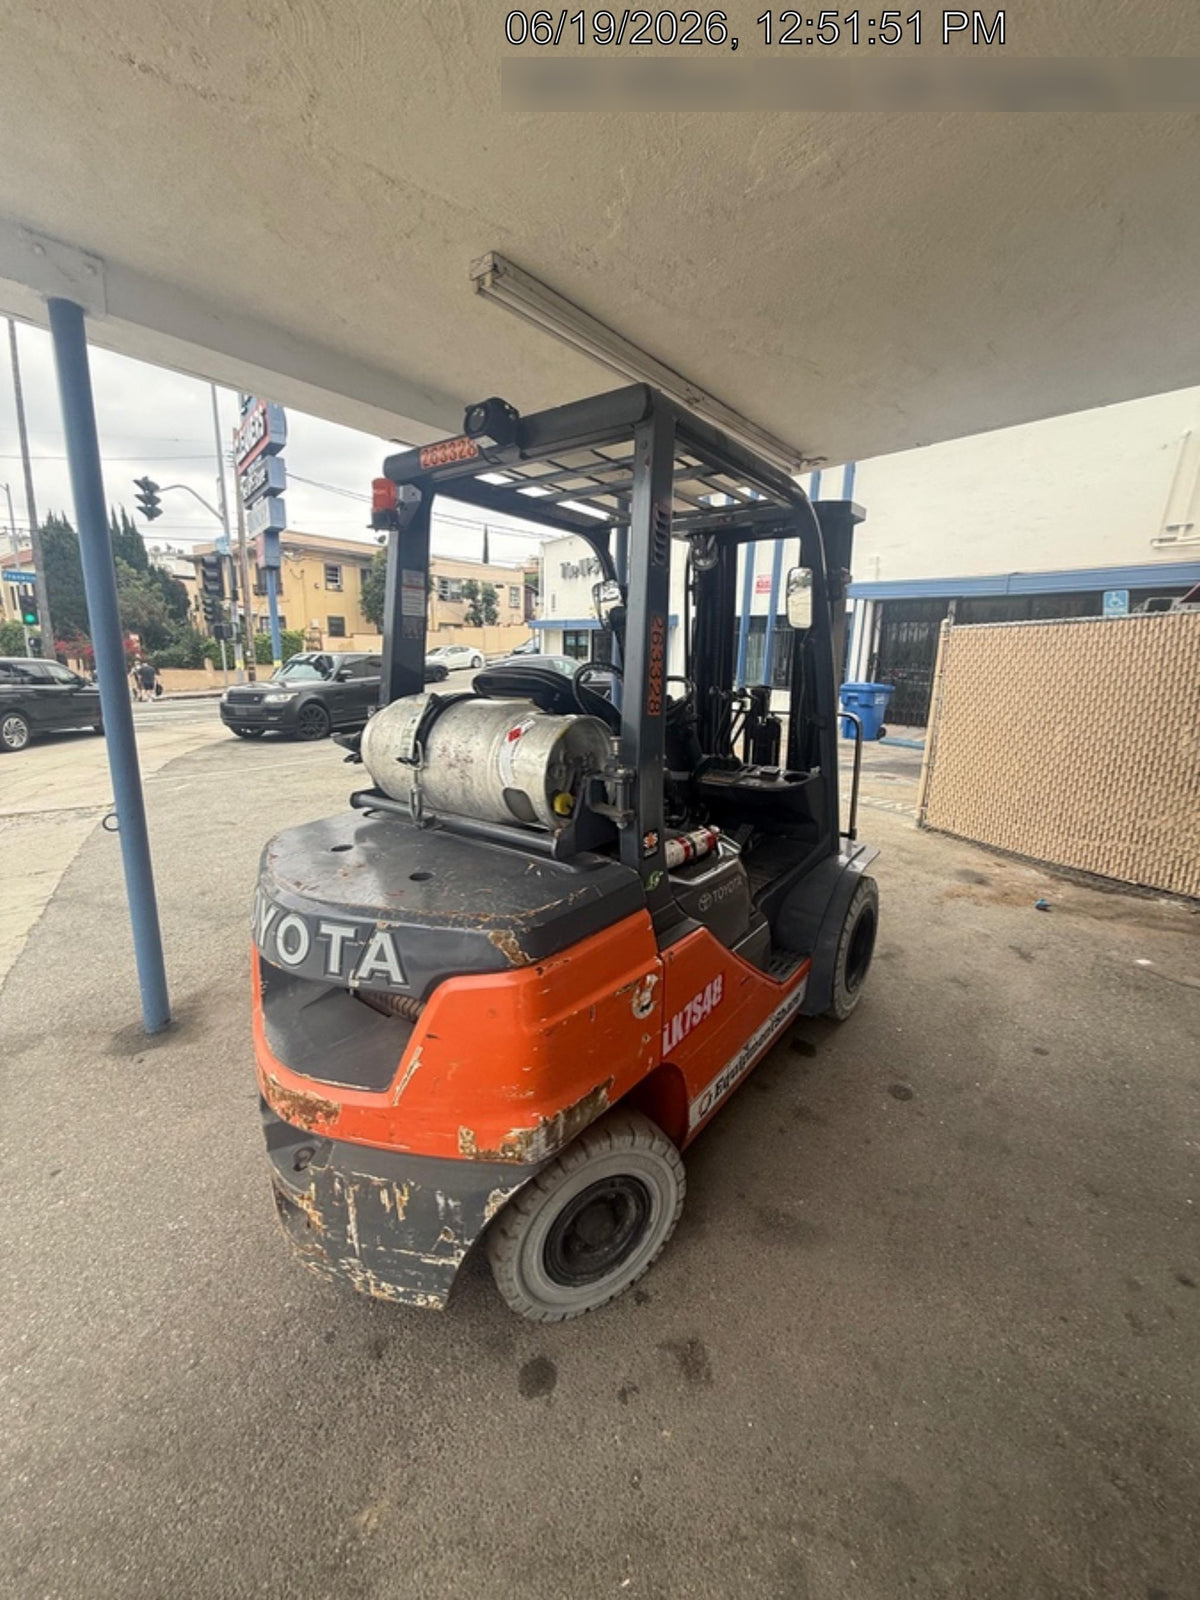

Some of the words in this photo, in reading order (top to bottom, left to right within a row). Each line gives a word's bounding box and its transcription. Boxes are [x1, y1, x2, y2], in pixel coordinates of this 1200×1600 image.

[422, 439, 477, 467] 263328
[649, 615, 663, 714] 263328
[255, 890, 406, 983] YOTA
